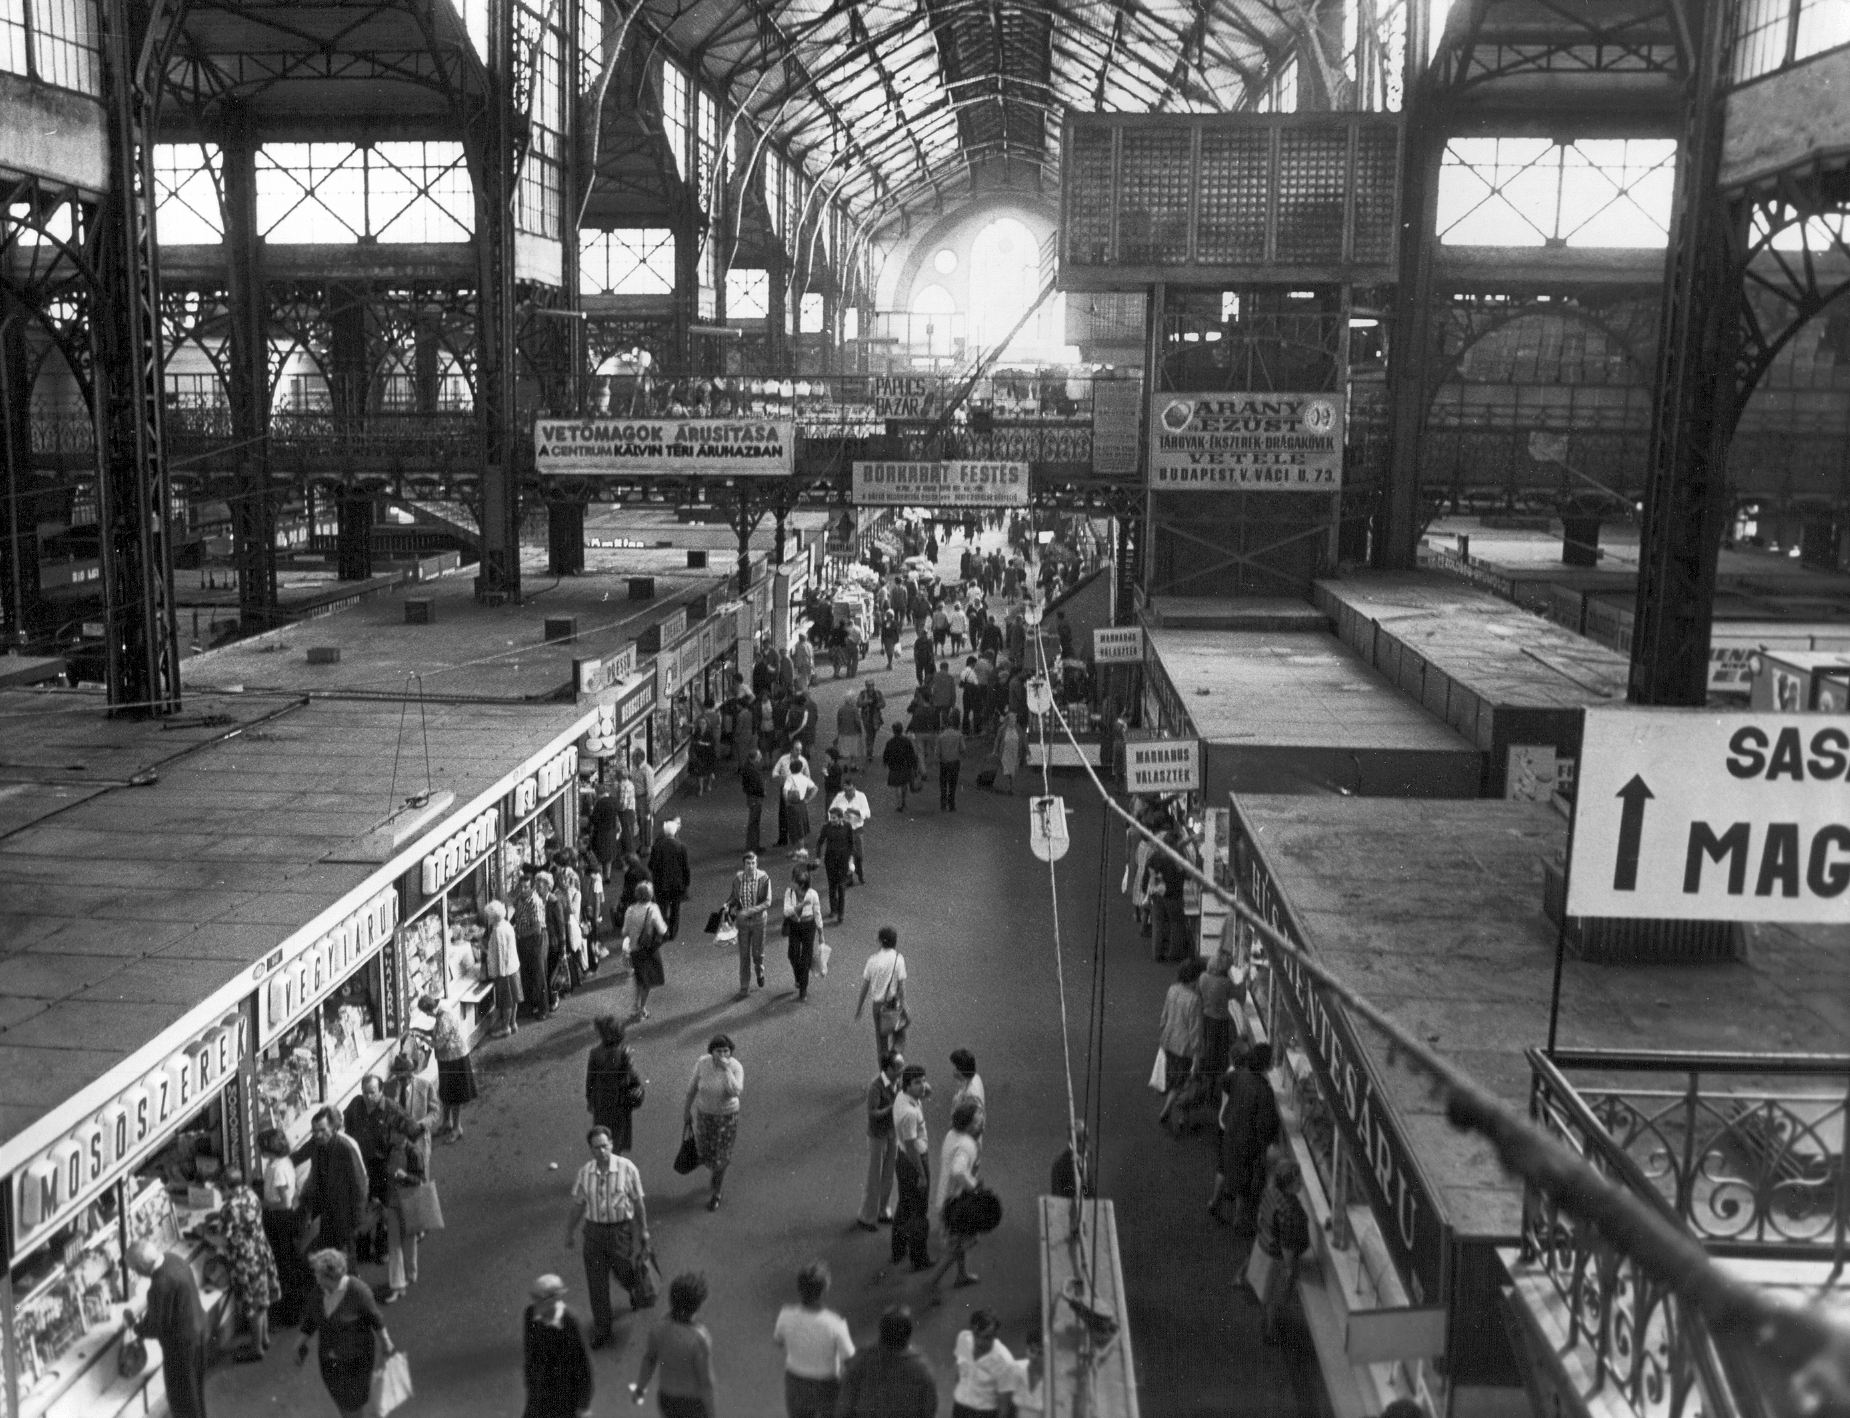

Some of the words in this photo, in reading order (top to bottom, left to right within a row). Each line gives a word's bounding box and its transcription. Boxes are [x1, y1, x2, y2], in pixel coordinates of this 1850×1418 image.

[1194, 401, 1303, 415] ARANY
[538, 445, 549, 457] A
[551, 445, 613, 457] CENTRUM
[1726, 725, 1850, 782] SAS
